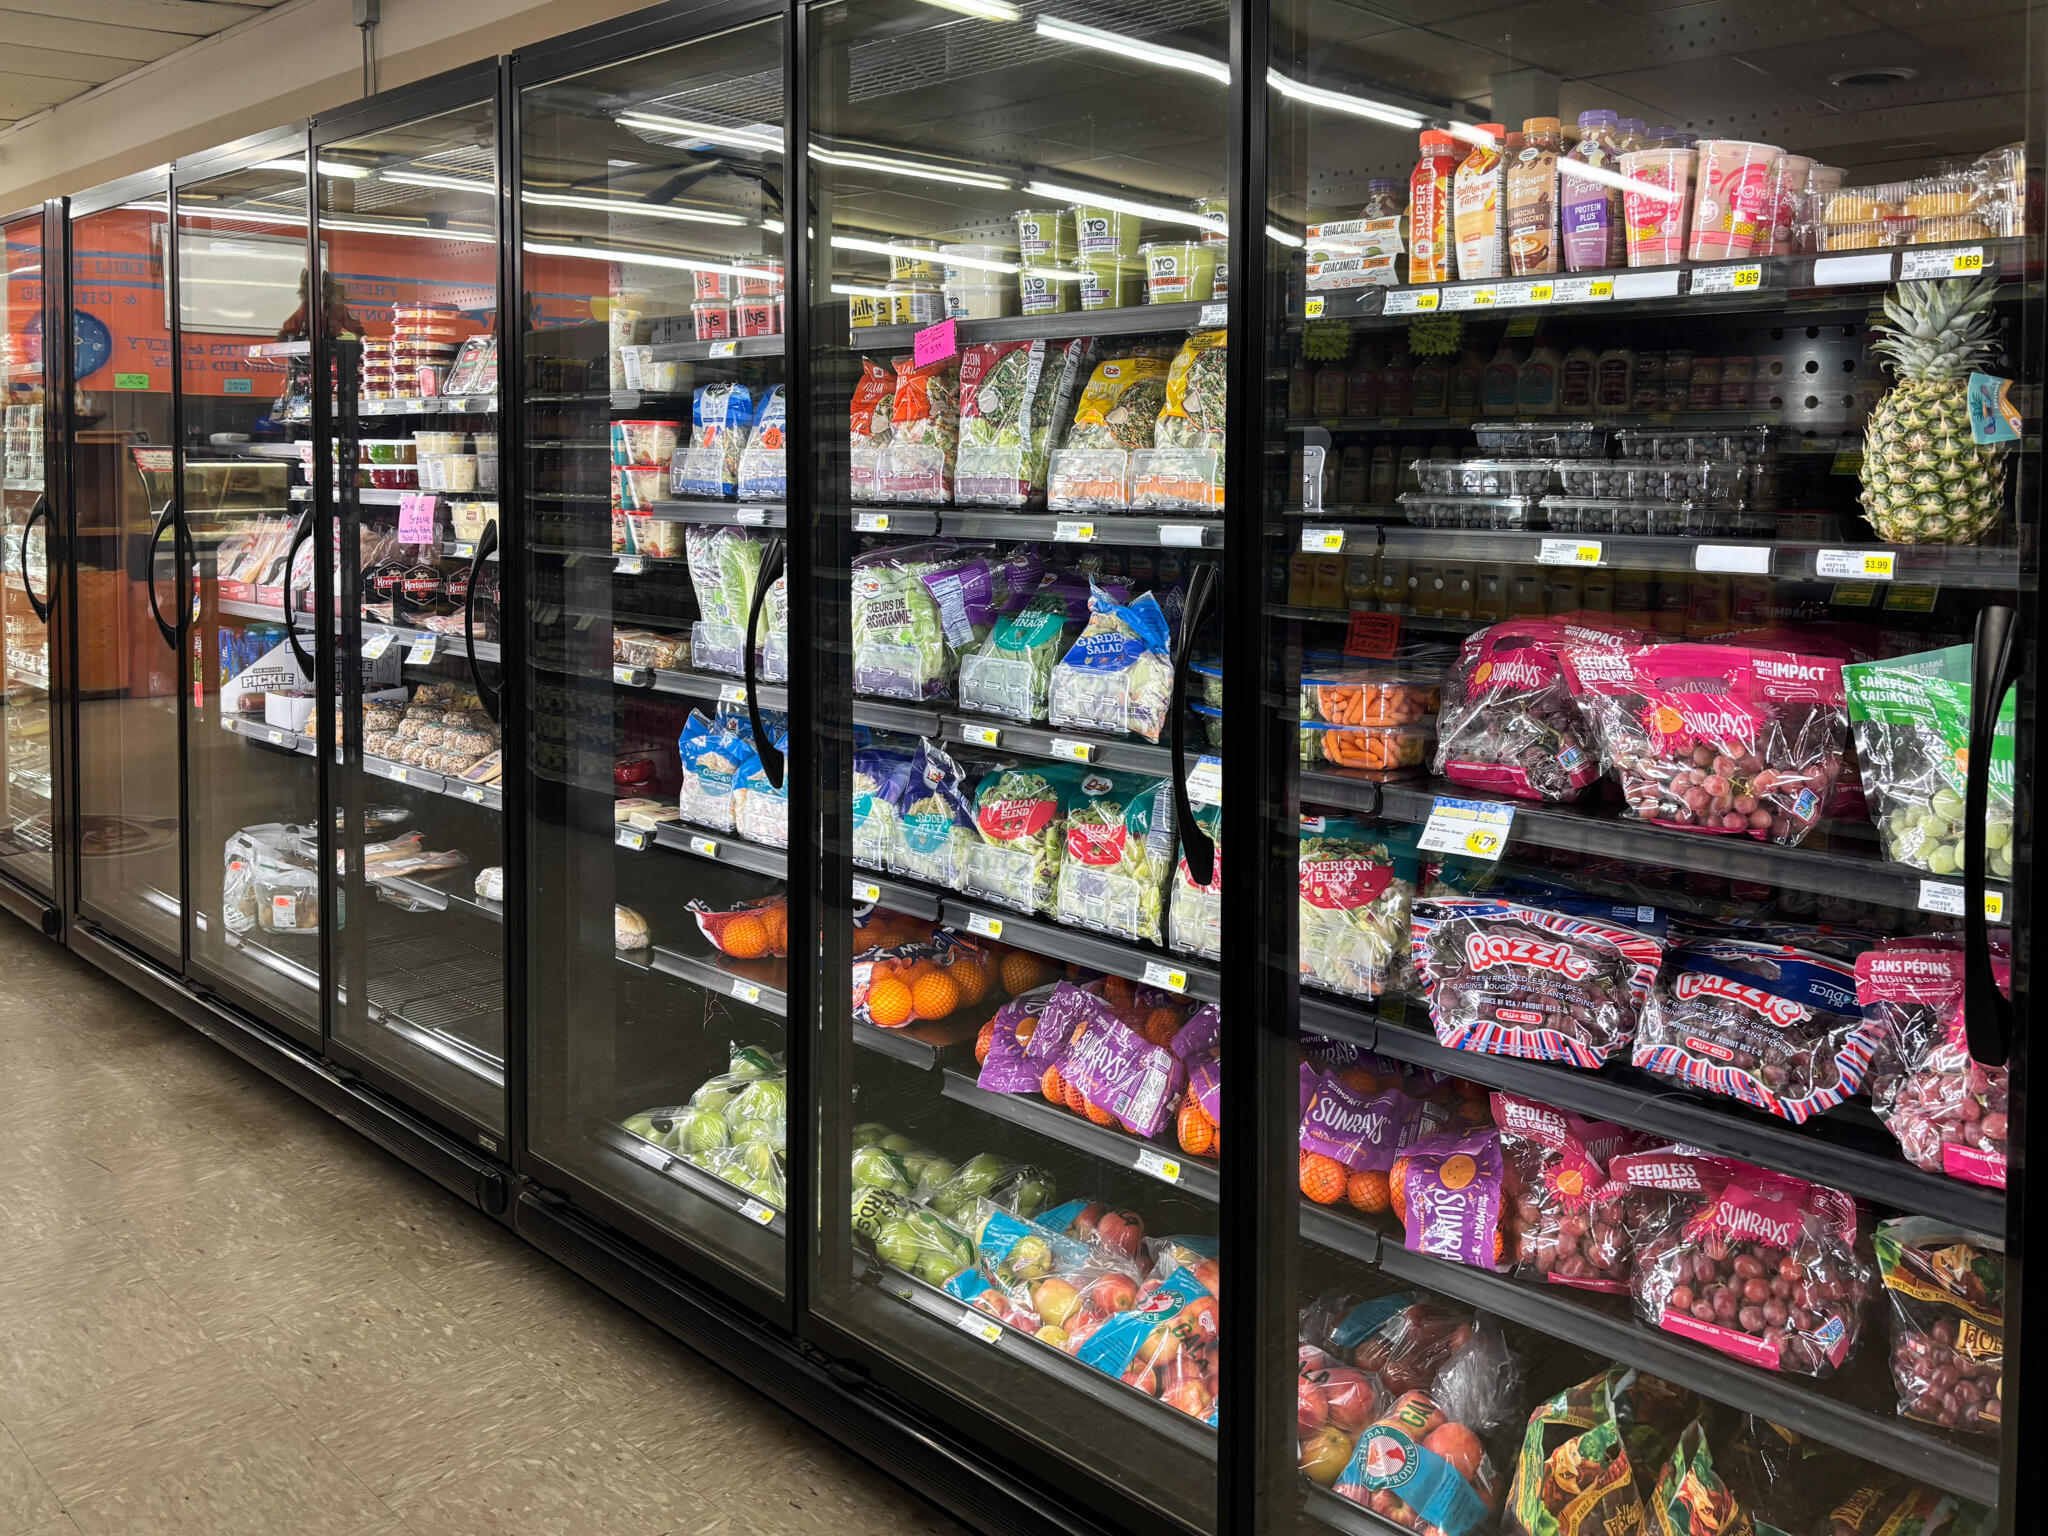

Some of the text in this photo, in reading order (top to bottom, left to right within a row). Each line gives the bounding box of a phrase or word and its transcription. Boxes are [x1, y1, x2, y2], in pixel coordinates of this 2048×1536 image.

[1460, 193, 1485, 208] Farms
[1415, 184, 1426, 236] SUPER
[1513, 208, 1536, 218] MOCHA
[1575, 202, 1601, 215] PROTEIN
[1580, 213, 1596, 222] PLUS
[1323, 222, 1362, 237] GUACAMOLE
[1322, 260, 1360, 274] GUACAMOLE
[1530, 289, 1548, 298] $3.69
[1589, 287, 1607, 296] $3.69
[1865, 559, 1888, 570] $3.99
[895, 598, 906, 609] DE
[866, 608, 913, 628] ROMAINE
[1019, 610, 1042, 618] BABY
[1076, 633, 1127, 647] GARDEN
[1578, 628, 1624, 646] IMPACT
[1086, 643, 1123, 655] SALAD
[1574, 656, 1630, 670] SEEDLESS
[1752, 659, 1773, 669] SNACK
[1488, 661, 1543, 687] SUNRAYS
[1579, 670, 1635, 682] RED GRAPES
[1773, 663, 1826, 681] IMPACT
[241, 673, 294, 689] PICKLE
[1682, 711, 1749, 738] SUNRAYS
[1086, 779, 1110, 792] Dole
[1000, 808, 1030, 820] BLEND
[1302, 860, 1373, 874] AMERICAN
[1315, 871, 1358, 882] BLEND
[1467, 933, 1591, 981] Razzle
[1870, 958, 1951, 976] SANS PÉPINS
[1466, 974, 1492, 983] FRESH
[1548, 981, 1584, 995] GRAPES
[1453, 983, 1482, 991] RAISINS
[1516, 986, 1541, 995] FRAIS
[1541, 988, 1564, 1000] SANS
[1564, 993, 1596, 1009] PÉPINS
[1505, 999, 1516, 1007] USA
[1521, 1001, 1545, 1011] PRODUIT
[1546, 1003, 1558, 1012] DES
[1520, 1013, 1536, 1022] 4023
[1692, 1003, 1707, 1014] RED
[1750, 1021, 1785, 1040] GRAPES
[1698, 1028, 1710, 1038] USA
[1715, 1035, 1739, 1049] PRODUIT
[1739, 1041, 1750, 1052] DES
[1738, 1025, 1763, 1040] SANS
[1075, 1030, 1127, 1081] SUNRAYS
[1710, 1046, 1727, 1058] 4023
[1312, 1097, 1384, 1145] SUNRAYS
[1505, 1103, 1567, 1129] SEEDLESS
[1506, 1118, 1567, 1140] RED GRAPES
[1627, 1164, 1697, 1180] SEEDLESS
[1654, 1178, 1701, 1190] GRAPES
[1474, 1203, 1487, 1241] IMPACT
[1716, 1201, 1790, 1246] SUNRAYS
[1385, 1442, 1416, 1486] PRODUCE
